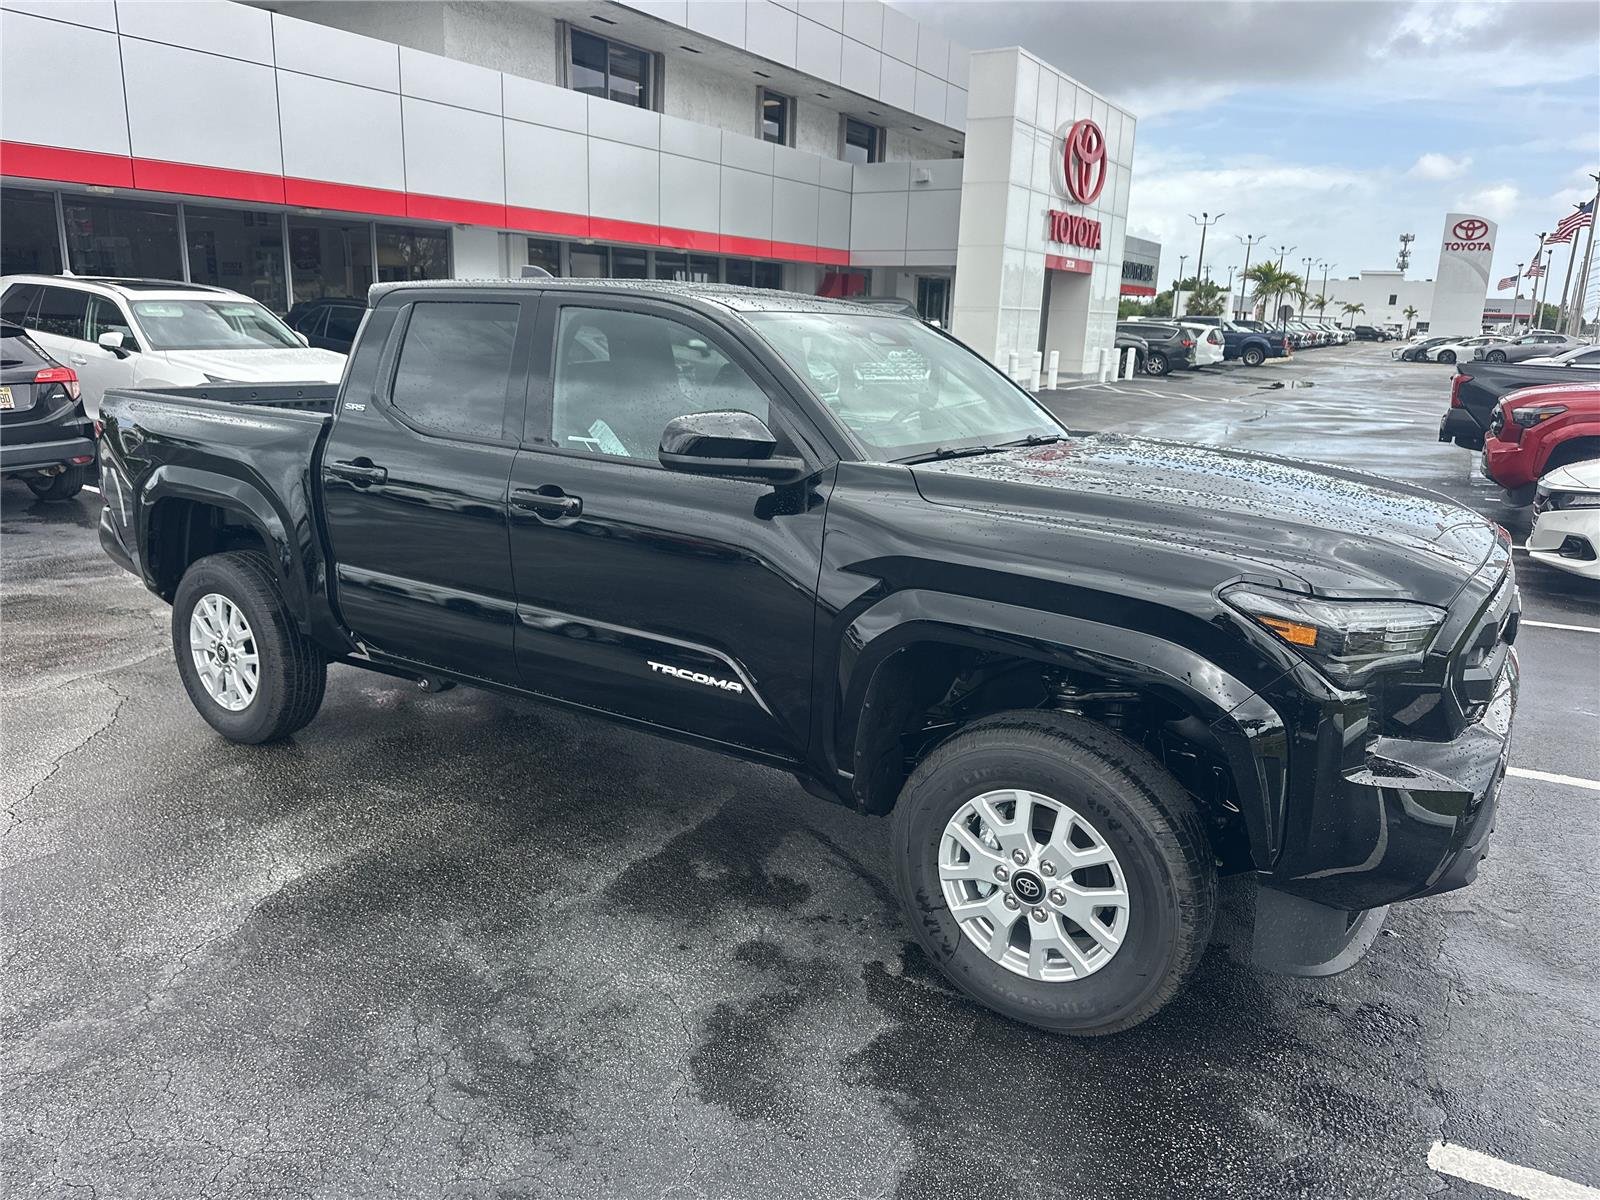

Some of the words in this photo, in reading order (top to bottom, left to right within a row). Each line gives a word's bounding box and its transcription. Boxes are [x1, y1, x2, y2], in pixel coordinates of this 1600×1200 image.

[1048, 209, 1102, 251] TOYOTA
[1444, 242, 1492, 252] TOYOTA
[344, 402, 366, 412] SR5
[646, 660, 744, 693] TACOMA
